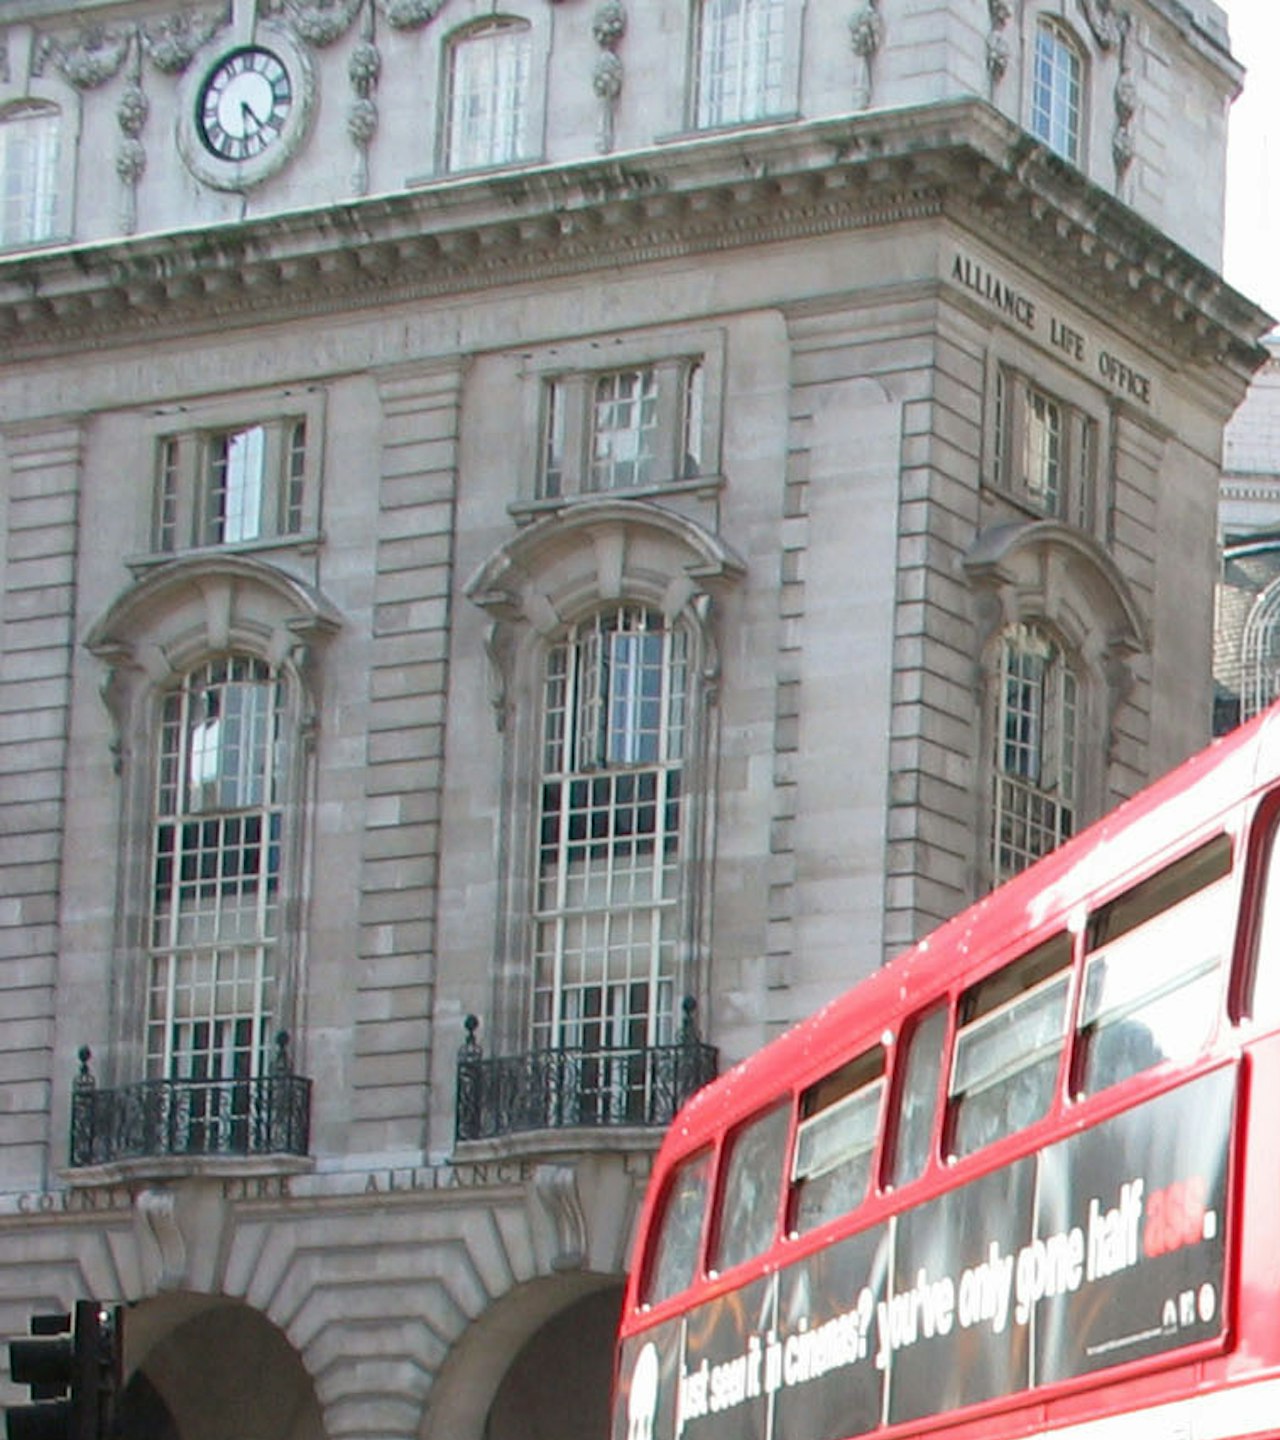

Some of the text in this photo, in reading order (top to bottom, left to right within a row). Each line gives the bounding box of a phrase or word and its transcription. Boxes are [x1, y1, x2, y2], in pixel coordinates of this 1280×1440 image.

[953, 254, 1151, 405] ALLIANCE LIFE OFFICE
[364, 1160, 533, 1194] ALLIANCE
[876, 1267, 955, 1370] you've
[958, 1241, 1014, 1334] only
[1015, 1227, 1084, 1326] gone
[1087, 1178, 1145, 1282] half
